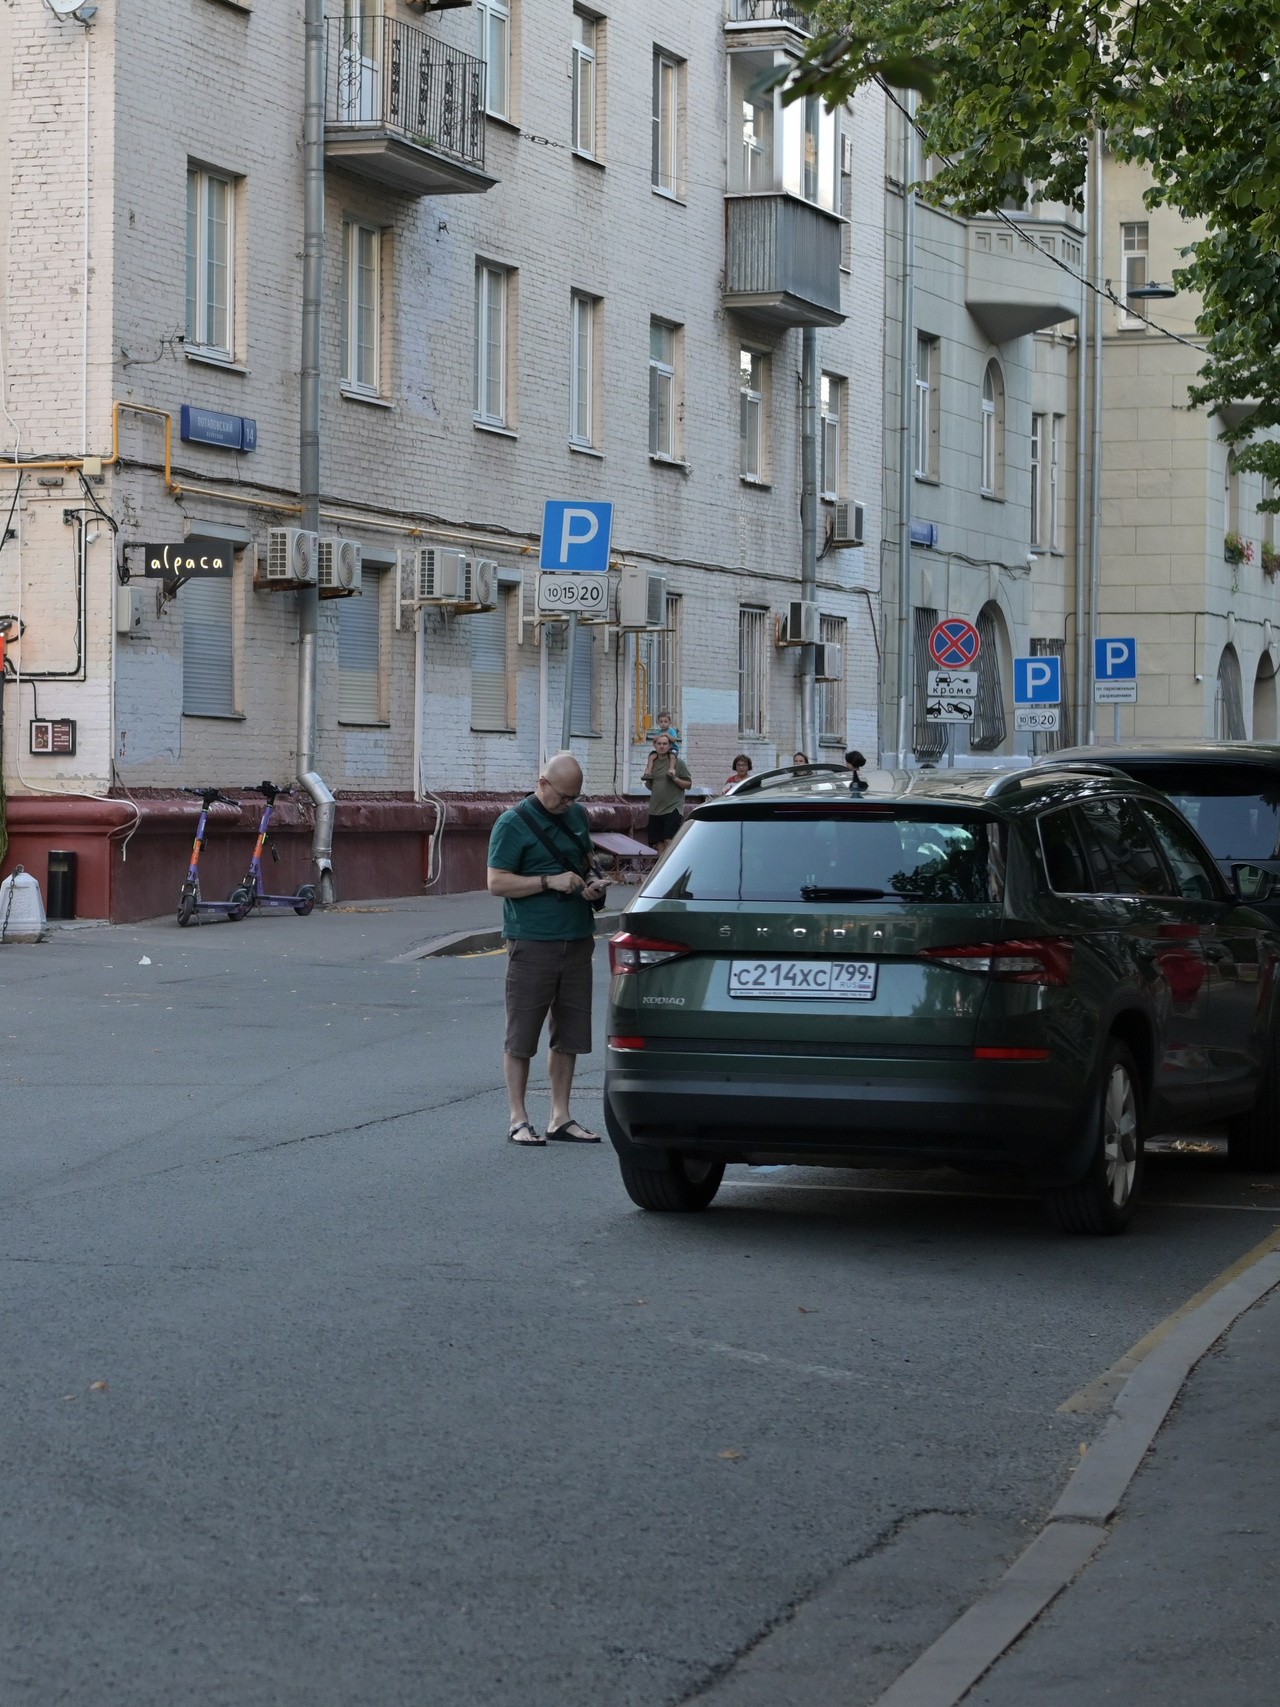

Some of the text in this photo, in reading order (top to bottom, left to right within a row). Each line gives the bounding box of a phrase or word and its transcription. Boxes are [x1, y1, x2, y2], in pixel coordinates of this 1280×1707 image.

[197, 416, 233, 433] ПОТАПОВСКИЙ
[246, 428, 255, 444] 14
[560, 508, 599, 563] P
[151, 545, 223, 575] alpaca
[548, 586, 600, 601] 10 15 20
[1106, 642, 1129, 676] P
[1026, 662, 1051, 699] P
[933, 687, 972, 696] кроме
[1029, 715, 1038, 725] 15
[1041, 715, 1054, 725] 20
[833, 963, 869, 982] 799
[642, 996, 686, 1007] KODIAQ
